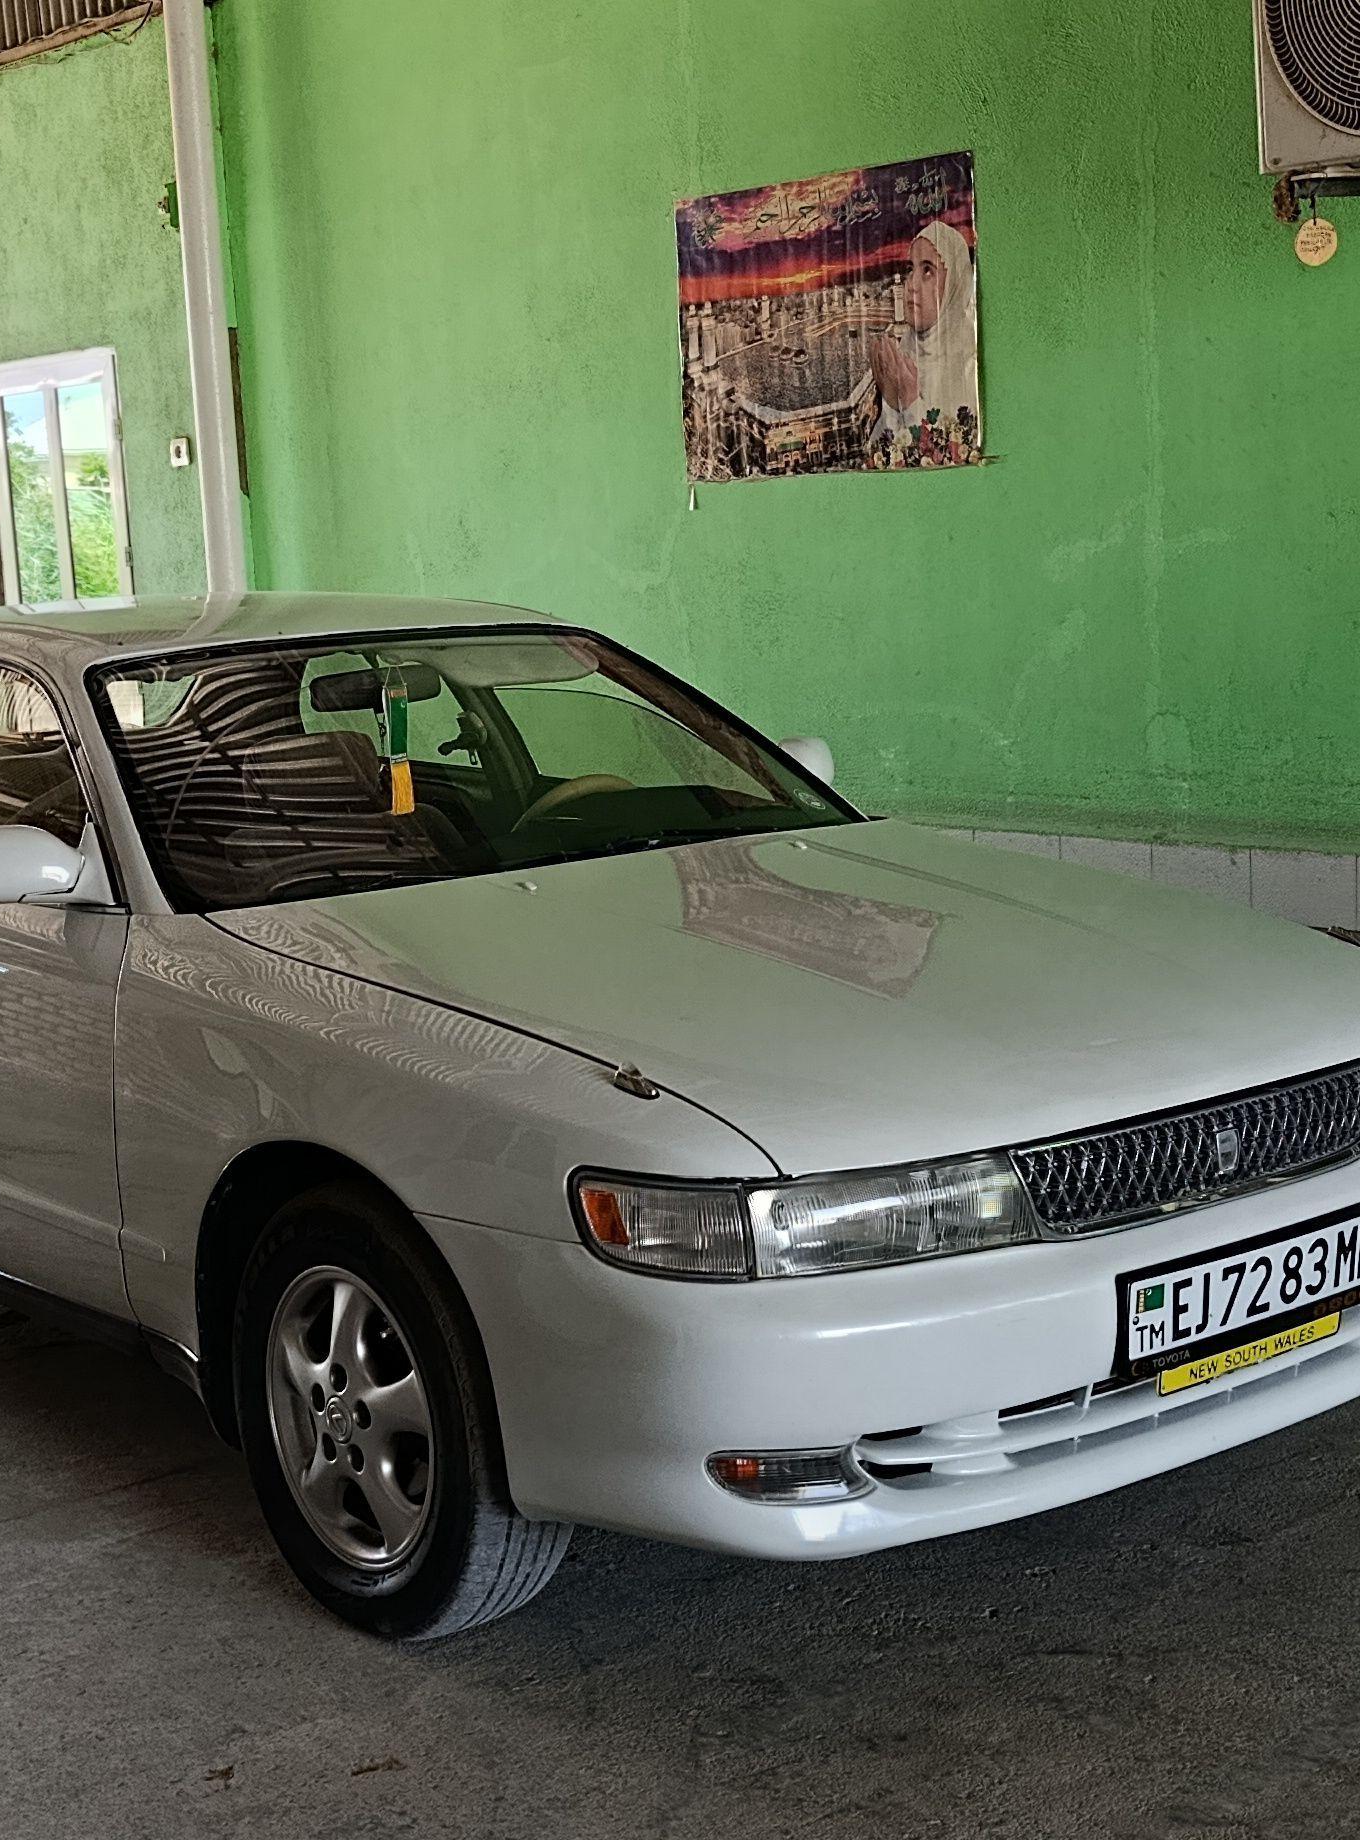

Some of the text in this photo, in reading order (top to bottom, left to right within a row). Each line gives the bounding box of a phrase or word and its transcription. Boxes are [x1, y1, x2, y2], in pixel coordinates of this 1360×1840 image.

[1135, 1320, 1165, 1353] TM
[1189, 1325, 1315, 1380] NEW SOUTH WALES
[1153, 1349, 1191, 1368] TOYOTA
